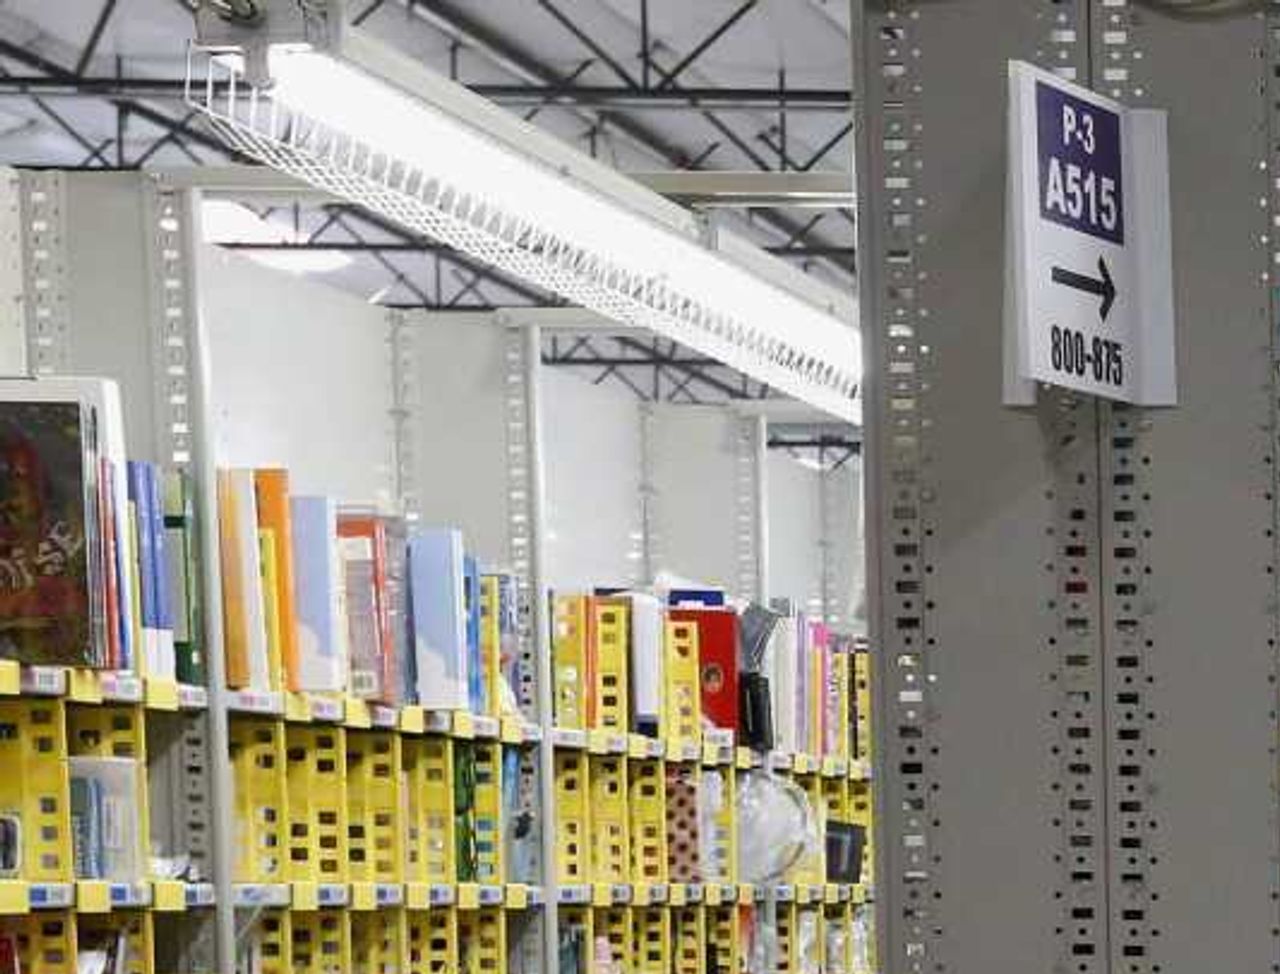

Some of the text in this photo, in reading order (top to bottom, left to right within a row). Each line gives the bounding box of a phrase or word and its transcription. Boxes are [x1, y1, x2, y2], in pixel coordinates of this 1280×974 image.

[1063, 103, 1095, 154] P-3
[1046, 156, 1117, 232] A515
[1050, 324, 1124, 386] 800-875
